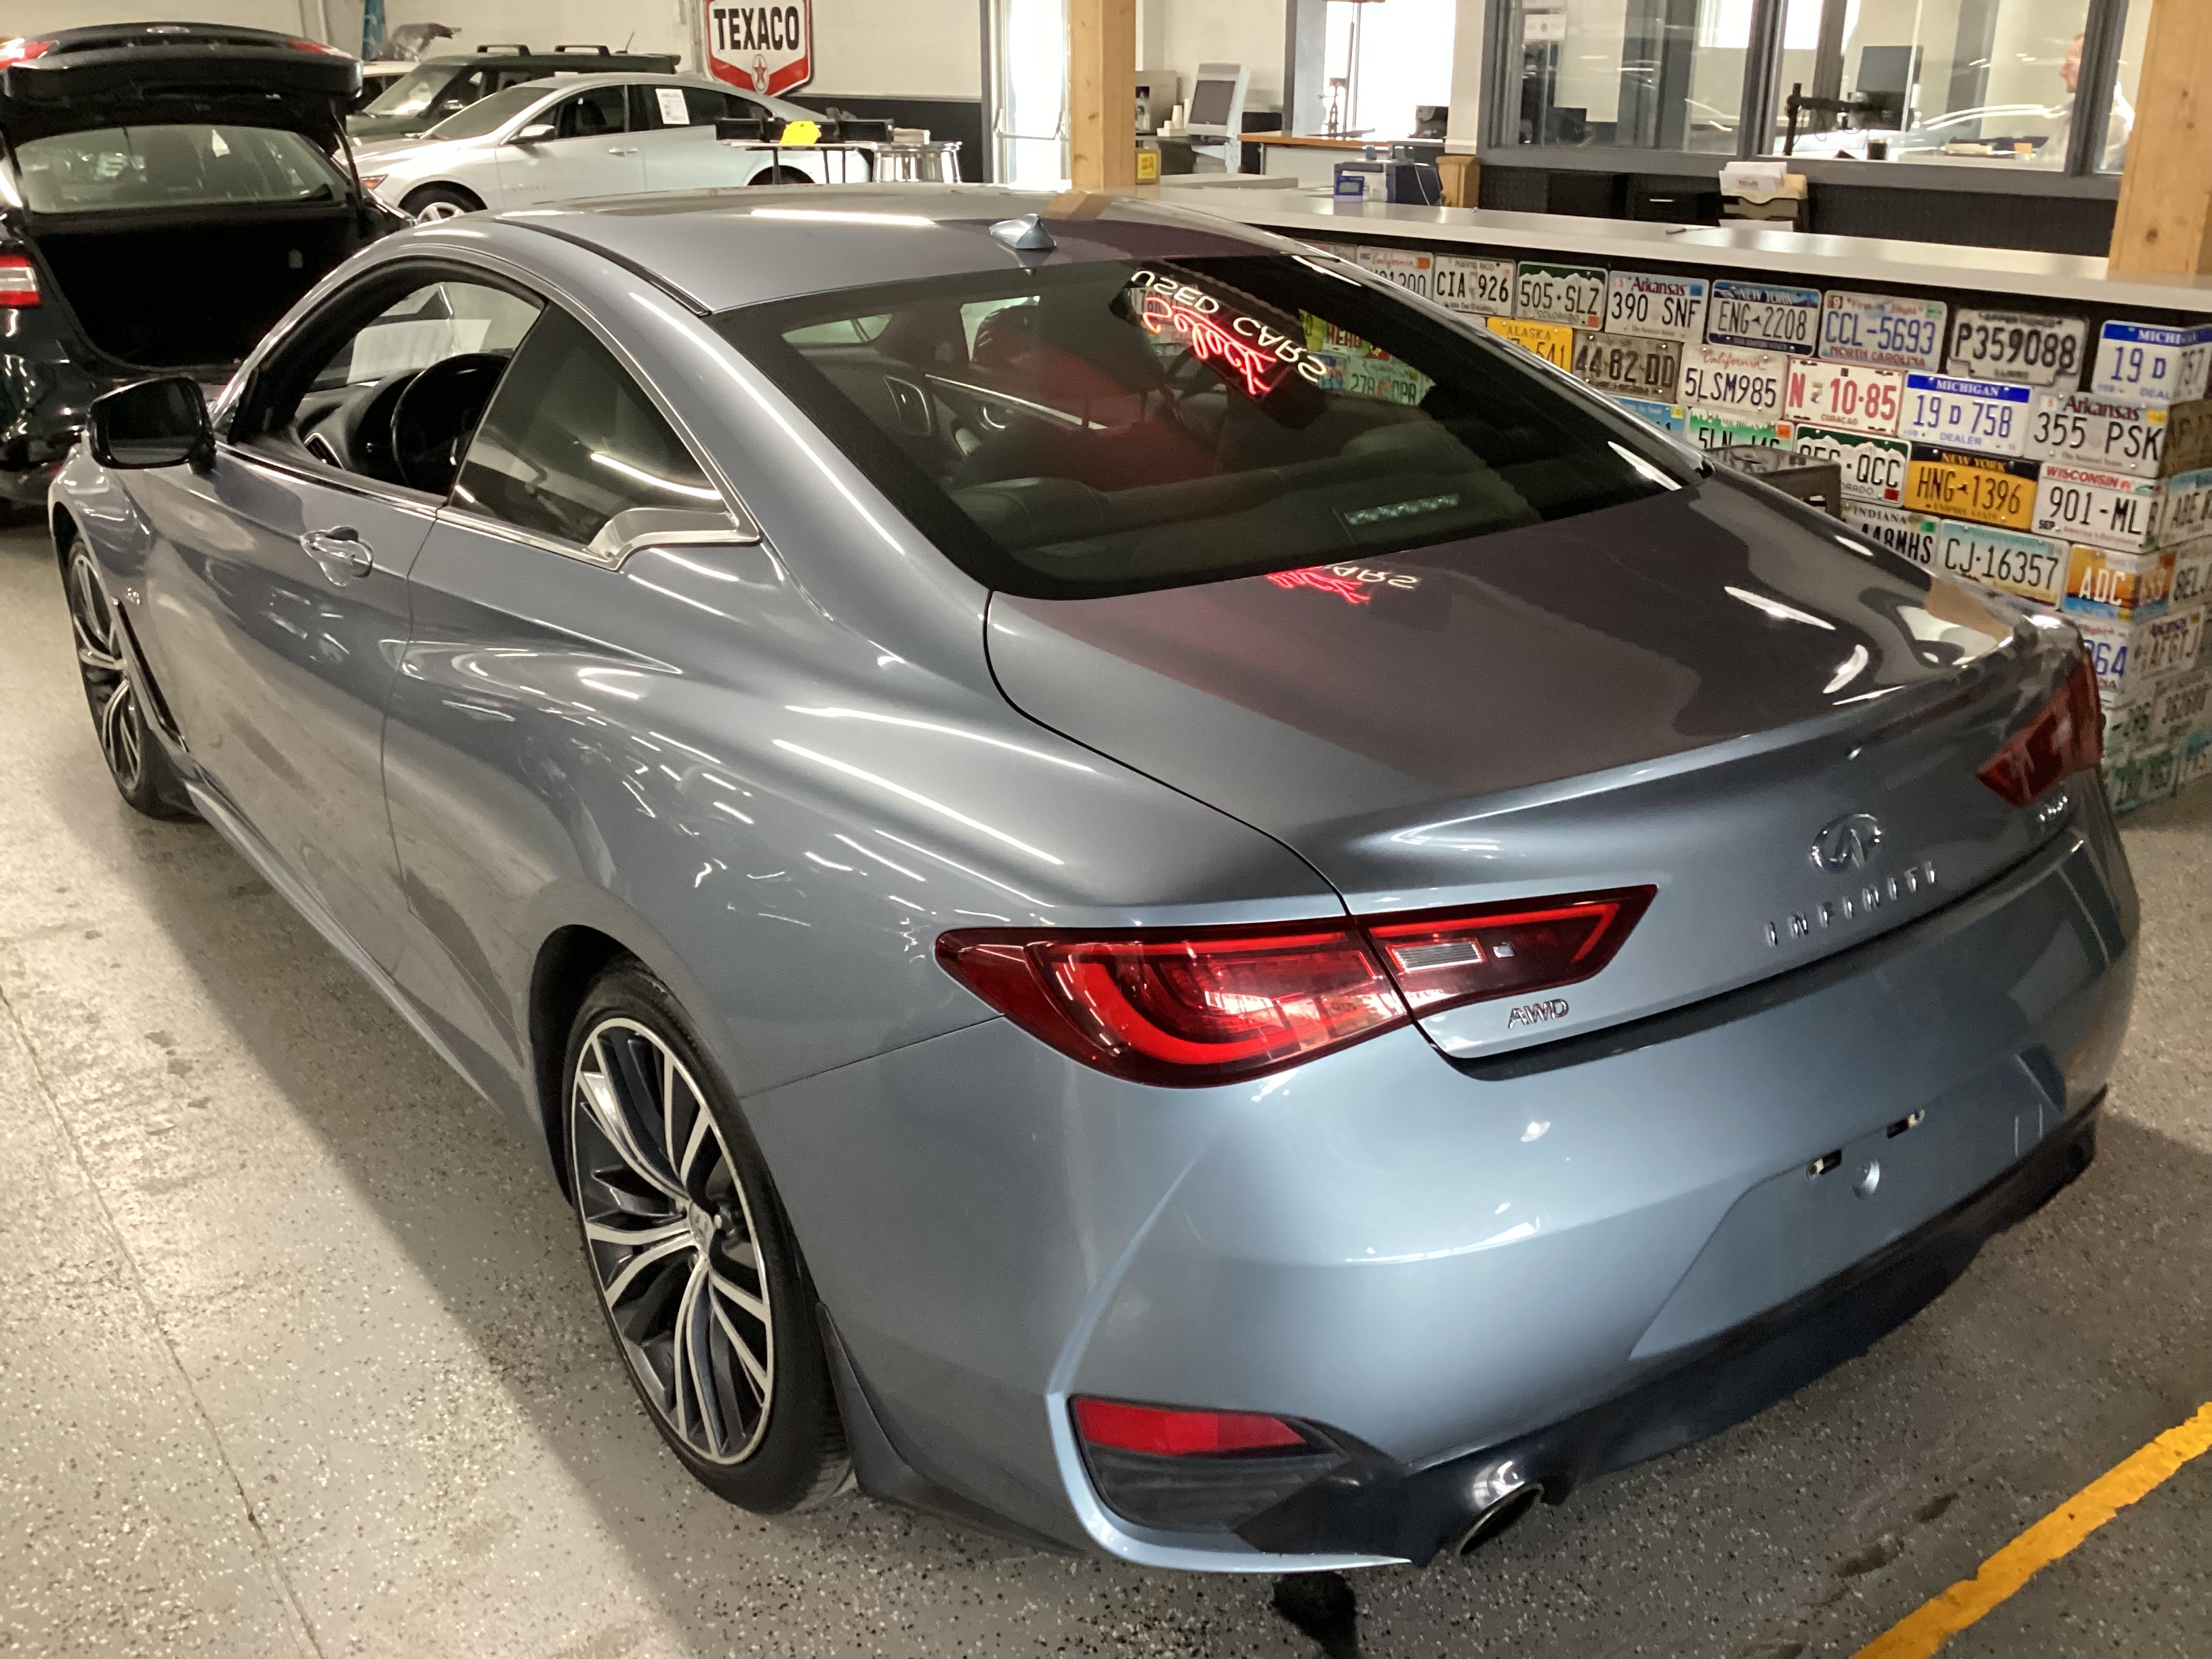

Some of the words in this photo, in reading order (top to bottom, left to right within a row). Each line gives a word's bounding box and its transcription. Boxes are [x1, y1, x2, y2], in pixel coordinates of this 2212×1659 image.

[713, 5, 800, 51] TEXACO
[1437, 271, 1465, 298] CIA
[1478, 274, 1509, 303] 926
[1631, 276, 1686, 297] Arkansas
[1611, 291, 1649, 323] 390
[1662, 296, 1702, 329] SNF
[1507, 325, 1551, 341] ALASKA
[1824, 310, 1936, 354] CCL-5693
[1954, 323, 2077, 369] P359088
[1702, 348, 1767, 371] California
[1830, 346, 1868, 360] NORTH
[1871, 351, 1925, 367] CAROLINA
[2110, 346, 2144, 383] 19
[2152, 357, 2167, 379] D
[1685, 367, 1777, 408] 5LSM985
[1788, 372, 1806, 408] N
[1936, 378, 1999, 397] MICHIGAN
[1912, 393, 1942, 428] 19
[1948, 404, 1962, 425] D
[1970, 400, 2013, 438] 758
[2062, 394, 2142, 422] Arkansas
[1939, 432, 1982, 446] DEALER
[2033, 411, 2087, 449] 355
[2104, 420, 2165, 462] PSK
[1941, 452, 1969, 466] NEW
[1973, 457, 2006, 473] YORK
[2046, 465, 2120, 489] WISCONSIN
[1853, 504, 1906, 525] INDIANA
[2039, 519, 2055, 530] SEP
[2078, 567, 2126, 606] ADC
[1764, 860, 1936, 948] INFINITI
[1507, 998, 1570, 1029] AWD
